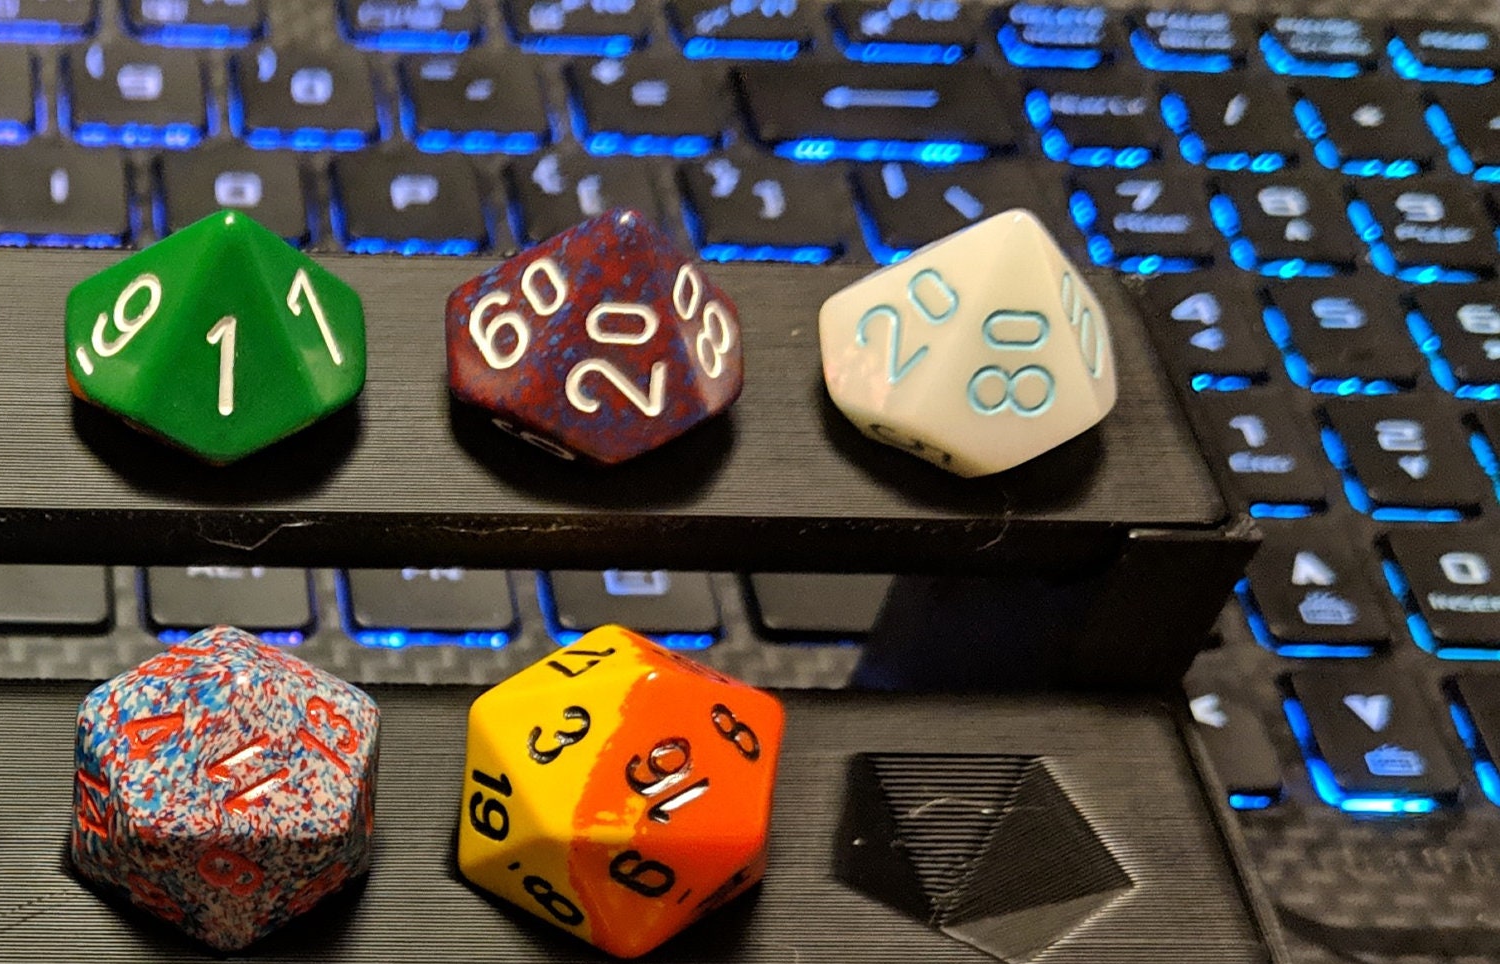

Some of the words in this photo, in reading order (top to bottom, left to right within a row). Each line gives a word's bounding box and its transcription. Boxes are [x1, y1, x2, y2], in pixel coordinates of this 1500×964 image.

[390, 174, 438, 210] P
[468, 257, 568, 370] 60
[854, 267, 960, 385] 20
[966, 308, 1057, 419] 80
[205, 315, 237, 417] 1
[527, 705, 591, 765] 3
[710, 703, 761, 763] 8
